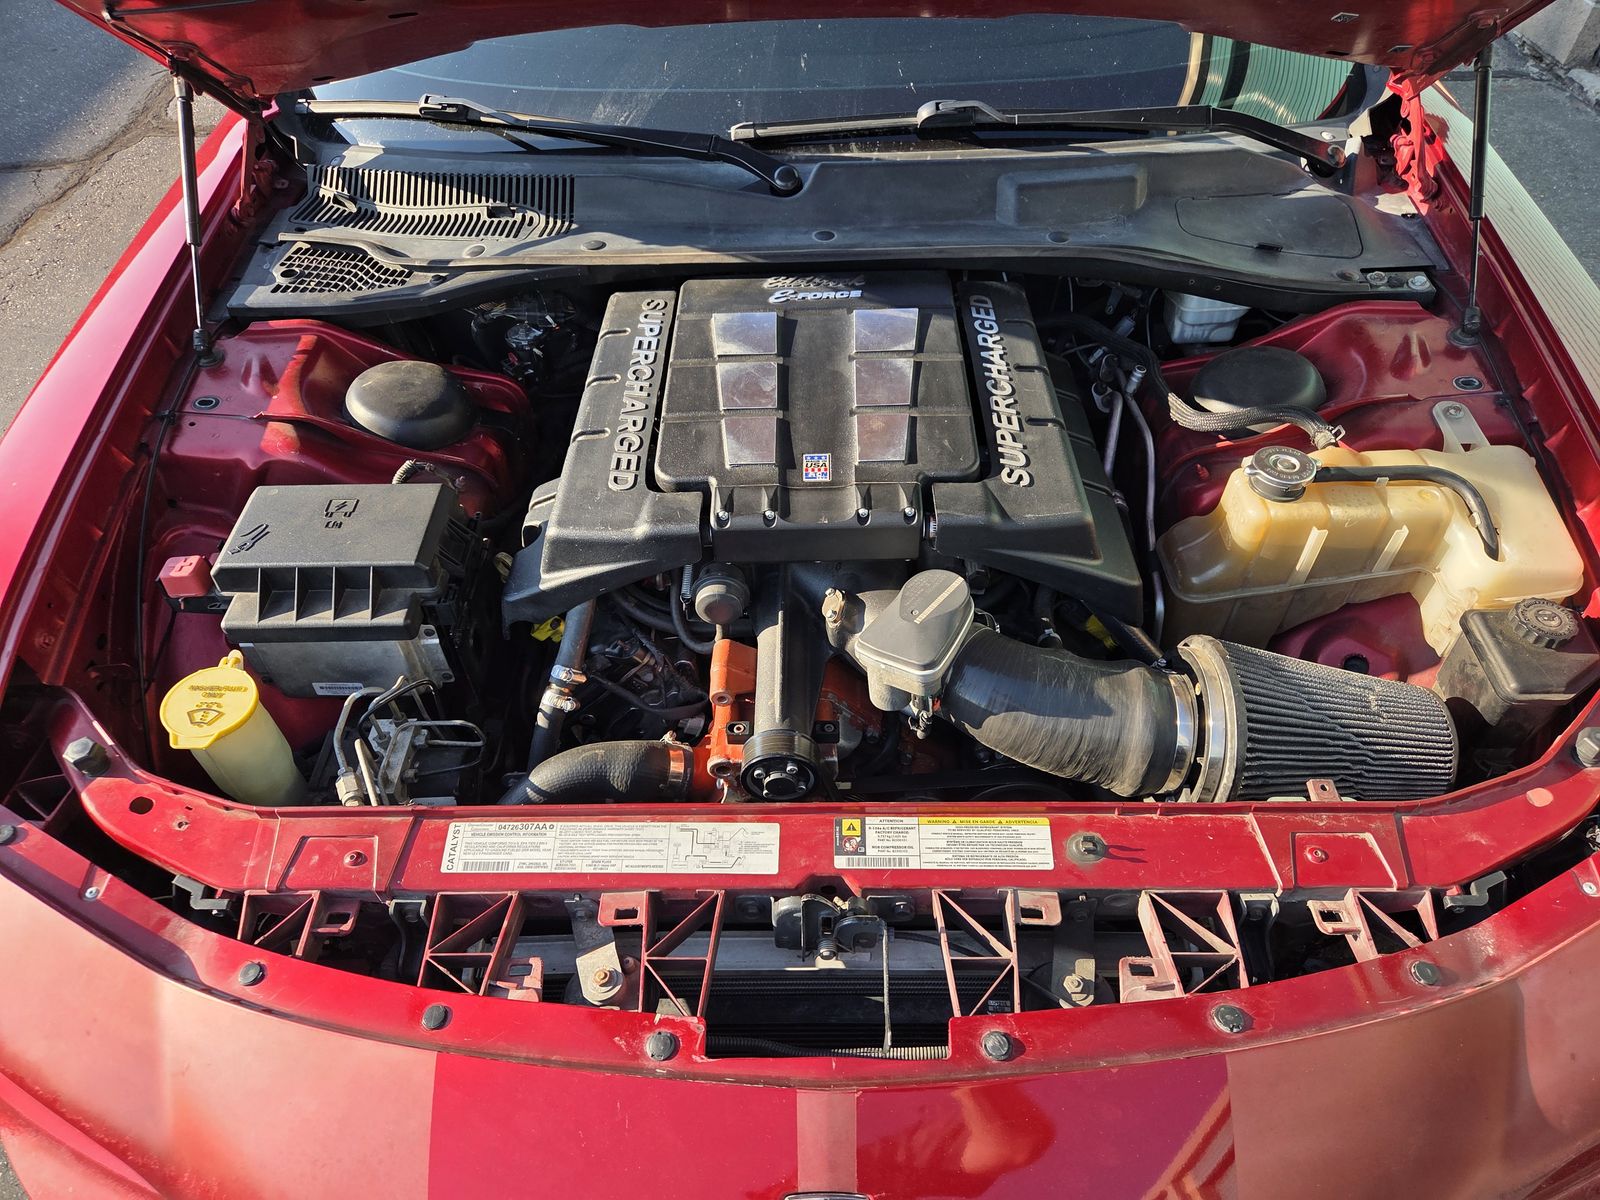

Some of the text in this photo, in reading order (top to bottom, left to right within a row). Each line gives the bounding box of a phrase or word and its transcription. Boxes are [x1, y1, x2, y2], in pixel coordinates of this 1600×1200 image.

[608, 298, 667, 491] SUPERCHARGED
[970, 294, 1031, 488] SUPERCHARGED
[446, 823, 462, 871] CATALYST
[498, 823, 548, 831] 04726307AA
